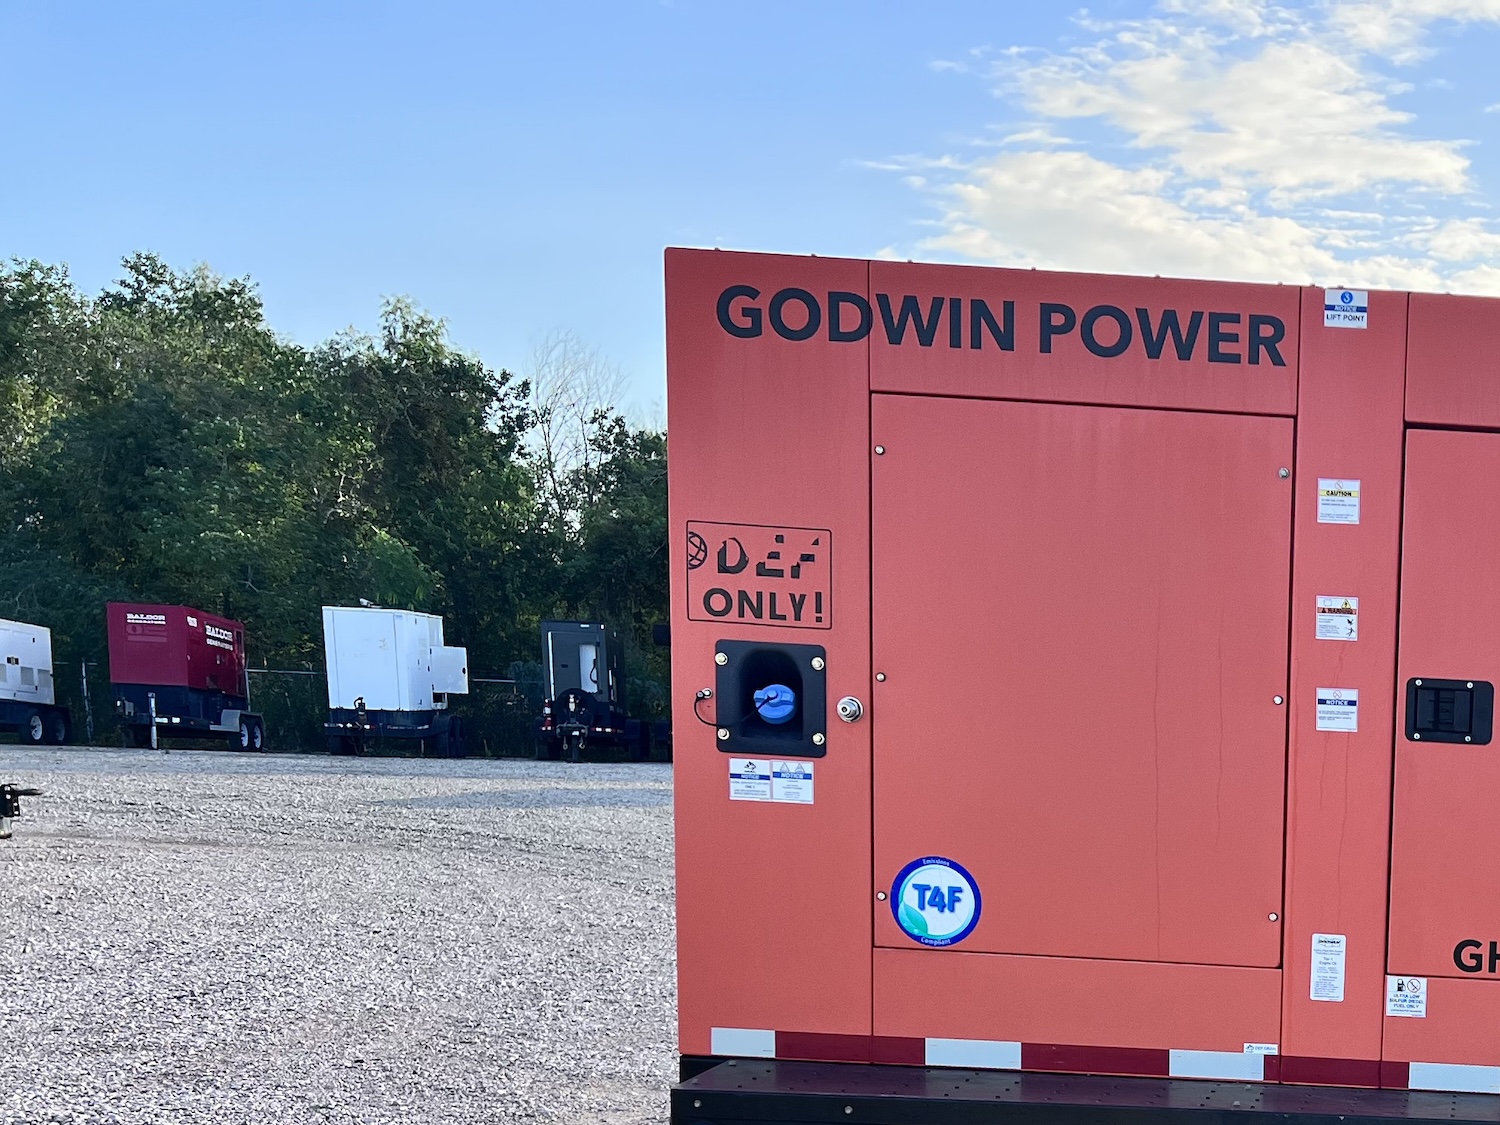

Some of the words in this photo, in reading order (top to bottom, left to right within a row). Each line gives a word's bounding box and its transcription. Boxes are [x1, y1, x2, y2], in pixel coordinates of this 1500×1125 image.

[716, 284, 1015, 351] GODWIN
[1039, 302, 1286, 366] POWER
[1343, 314, 1365, 322] POINT
[703, 587, 823, 623] ONLY!
[126, 613, 166, 621] BALDOR
[205, 625, 233, 642] BALDOR
[911, 883, 963, 913] T4F
[920, 936, 951, 947] Compliant
